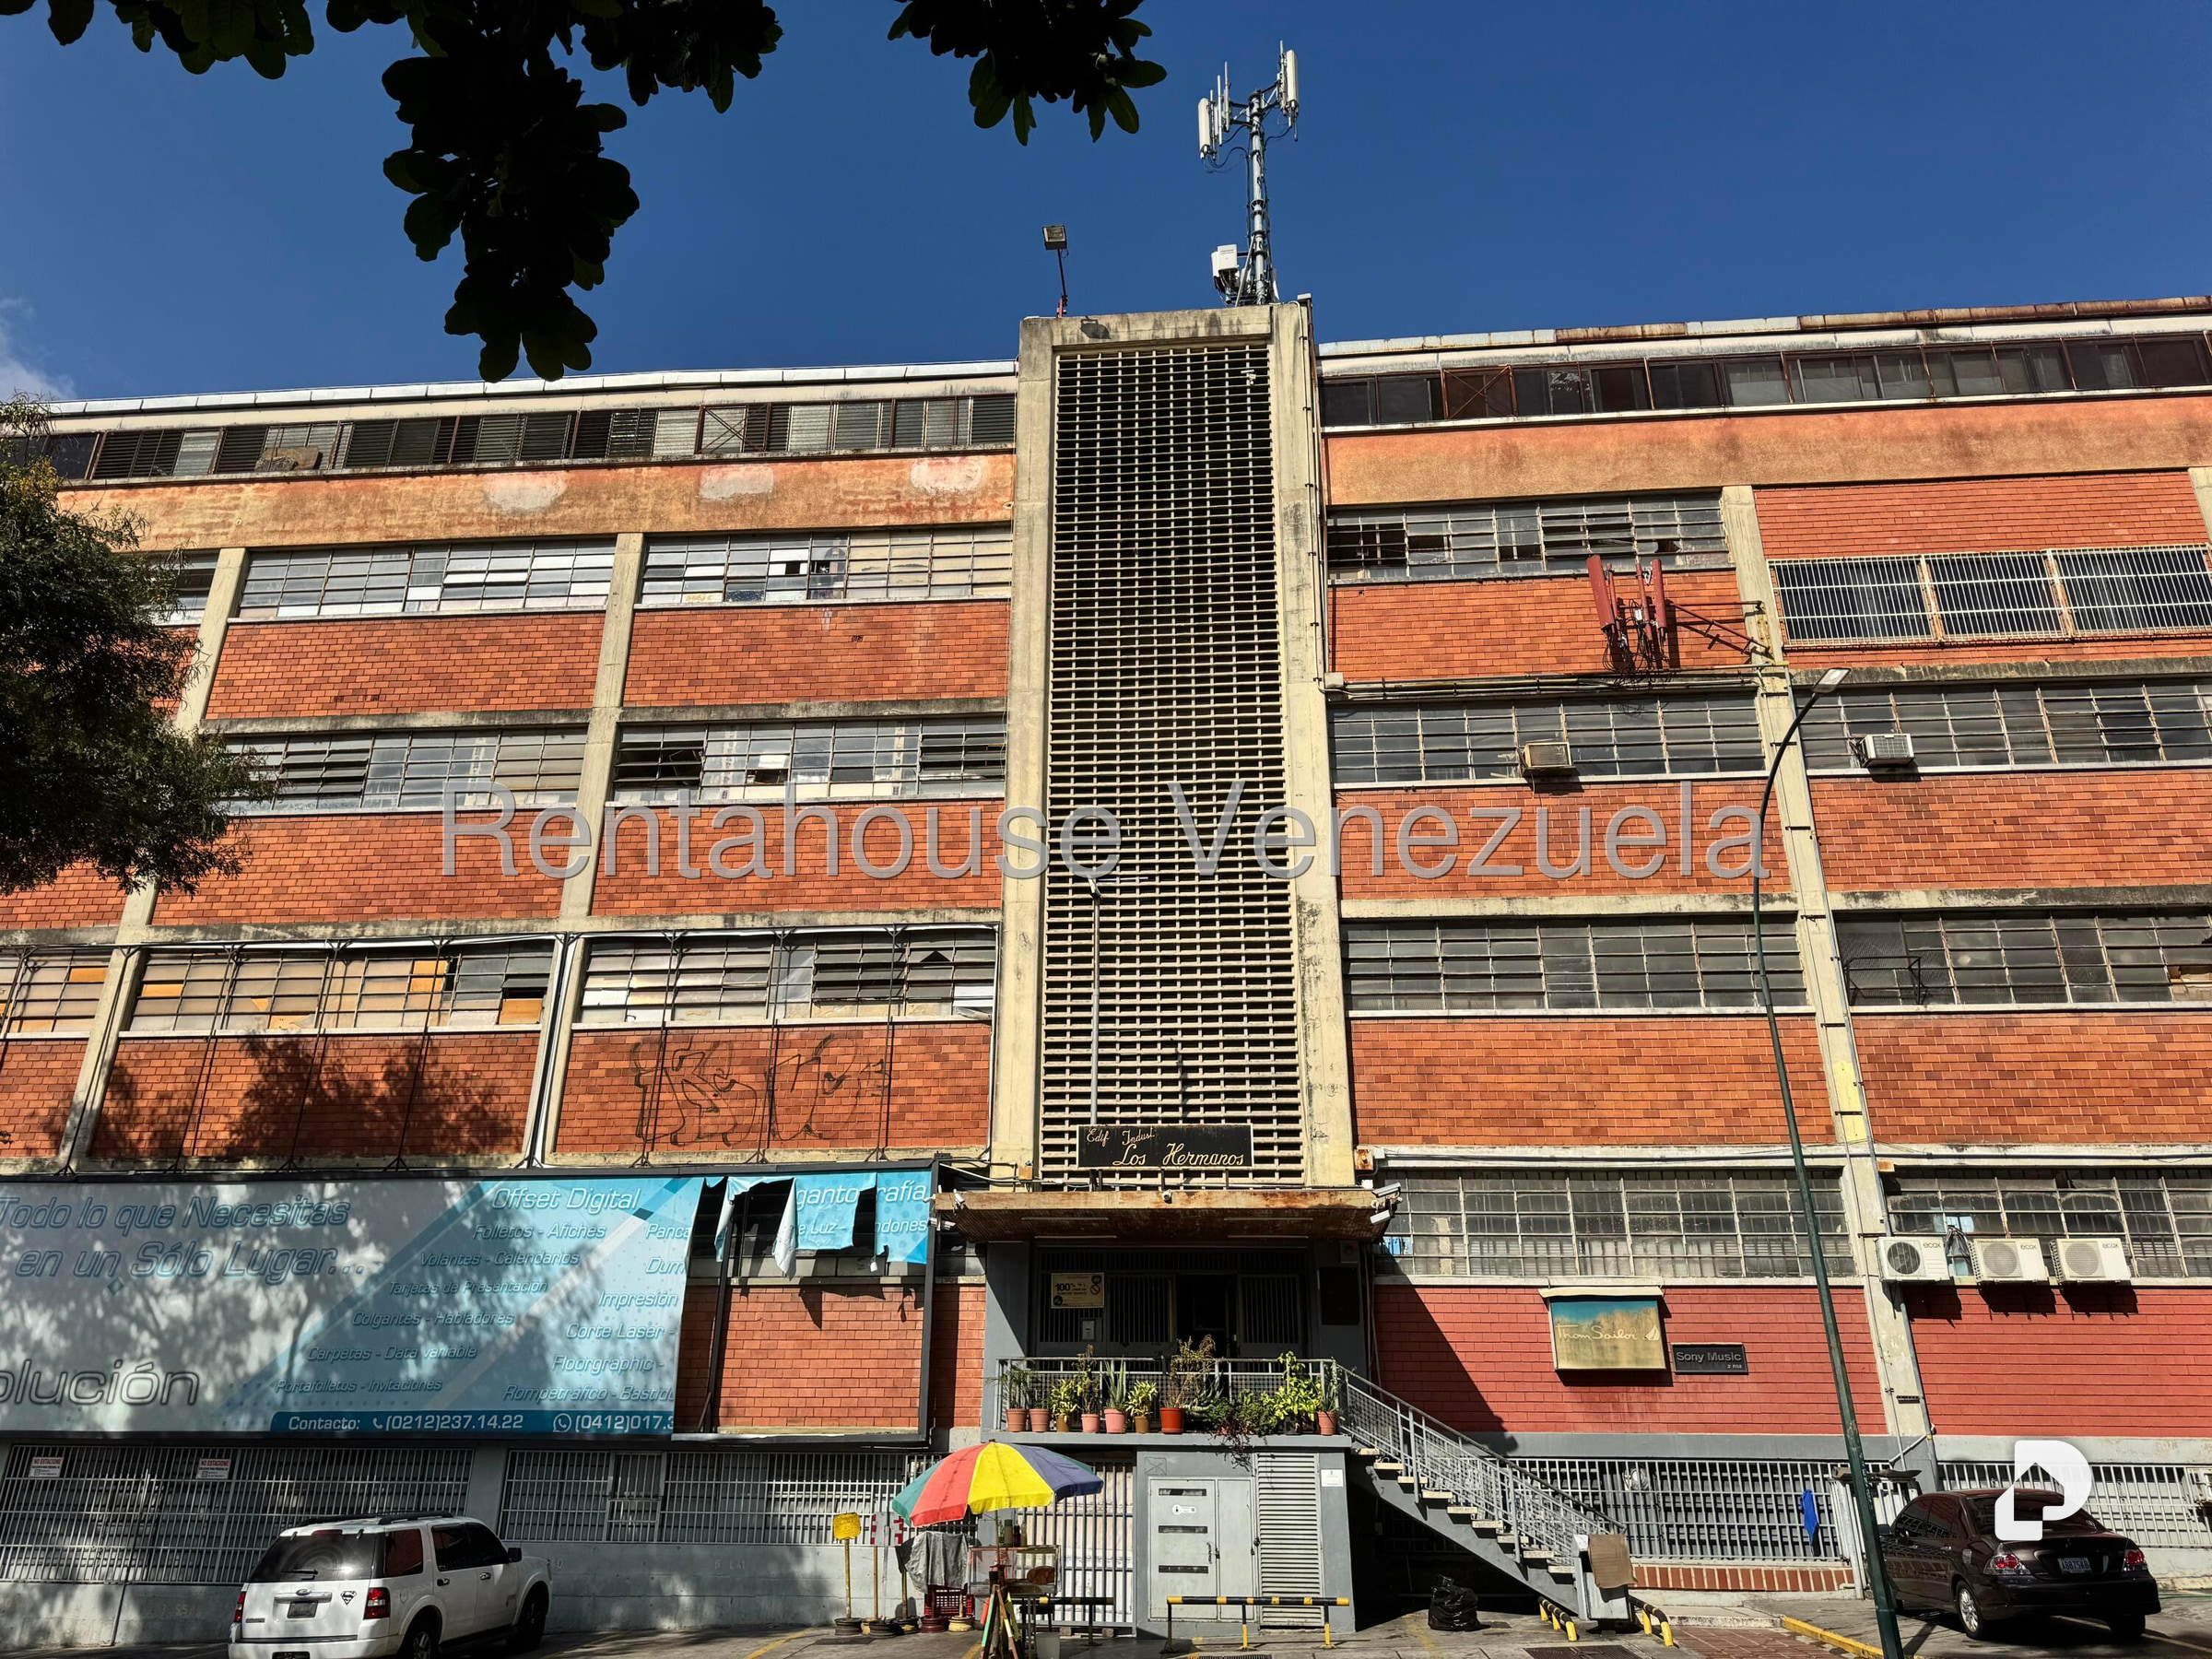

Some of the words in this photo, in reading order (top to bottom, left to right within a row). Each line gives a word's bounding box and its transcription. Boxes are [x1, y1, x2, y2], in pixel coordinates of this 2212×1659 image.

[1112, 1143, 1147, 1166] Los
[1162, 1143, 1244, 1166] Hermanos
[491, 1188, 560, 1210] Offset
[565, 1188, 641, 1214] Digital
[0, 1197, 72, 1229] Todo
[76, 1197, 106, 1229] lo
[114, 1203, 176, 1237] que
[182, 1194, 351, 1229] Necesitas
[472, 1224, 533, 1240] Folletos
[547, 1223, 606, 1239] Afiches
[15, 1250, 63, 1277] en
[73, 1250, 121, 1278] un
[130, 1241, 213, 1278] Sólo
[223, 1241, 365, 1286] Lugar...
[420, 1251, 481, 1266] Volantes
[494, 1250, 581, 1265] Calendarios
[389, 1281, 440, 1296] Tarjetas
[443, 1282, 458, 1294] de
[462, 1280, 547, 1294] Presentación
[598, 1290, 679, 1311] Impresión
[352, 1311, 422, 1327] Colgantes
[434, 1311, 515, 1325] Habladores
[566, 1323, 612, 1340] Corte
[617, 1324, 665, 1339] Laser
[306, 1346, 371, 1363] Carpetas
[383, 1346, 417, 1359] Data
[421, 1345, 477, 1359] variable
[1677, 1351, 1704, 1362] Sony
[1707, 1351, 1742, 1361] Music
[552, 1354, 654, 1374] Floorgraphic
[275, 1380, 357, 1394] Portafolletos
[368, 1380, 442, 1392] Invitaciones
[502, 1385, 608, 1404] Rompetráfico
[288, 1417, 360, 1430] Contacto:
[385, 1415, 524, 1431] (0212)237.14.22
